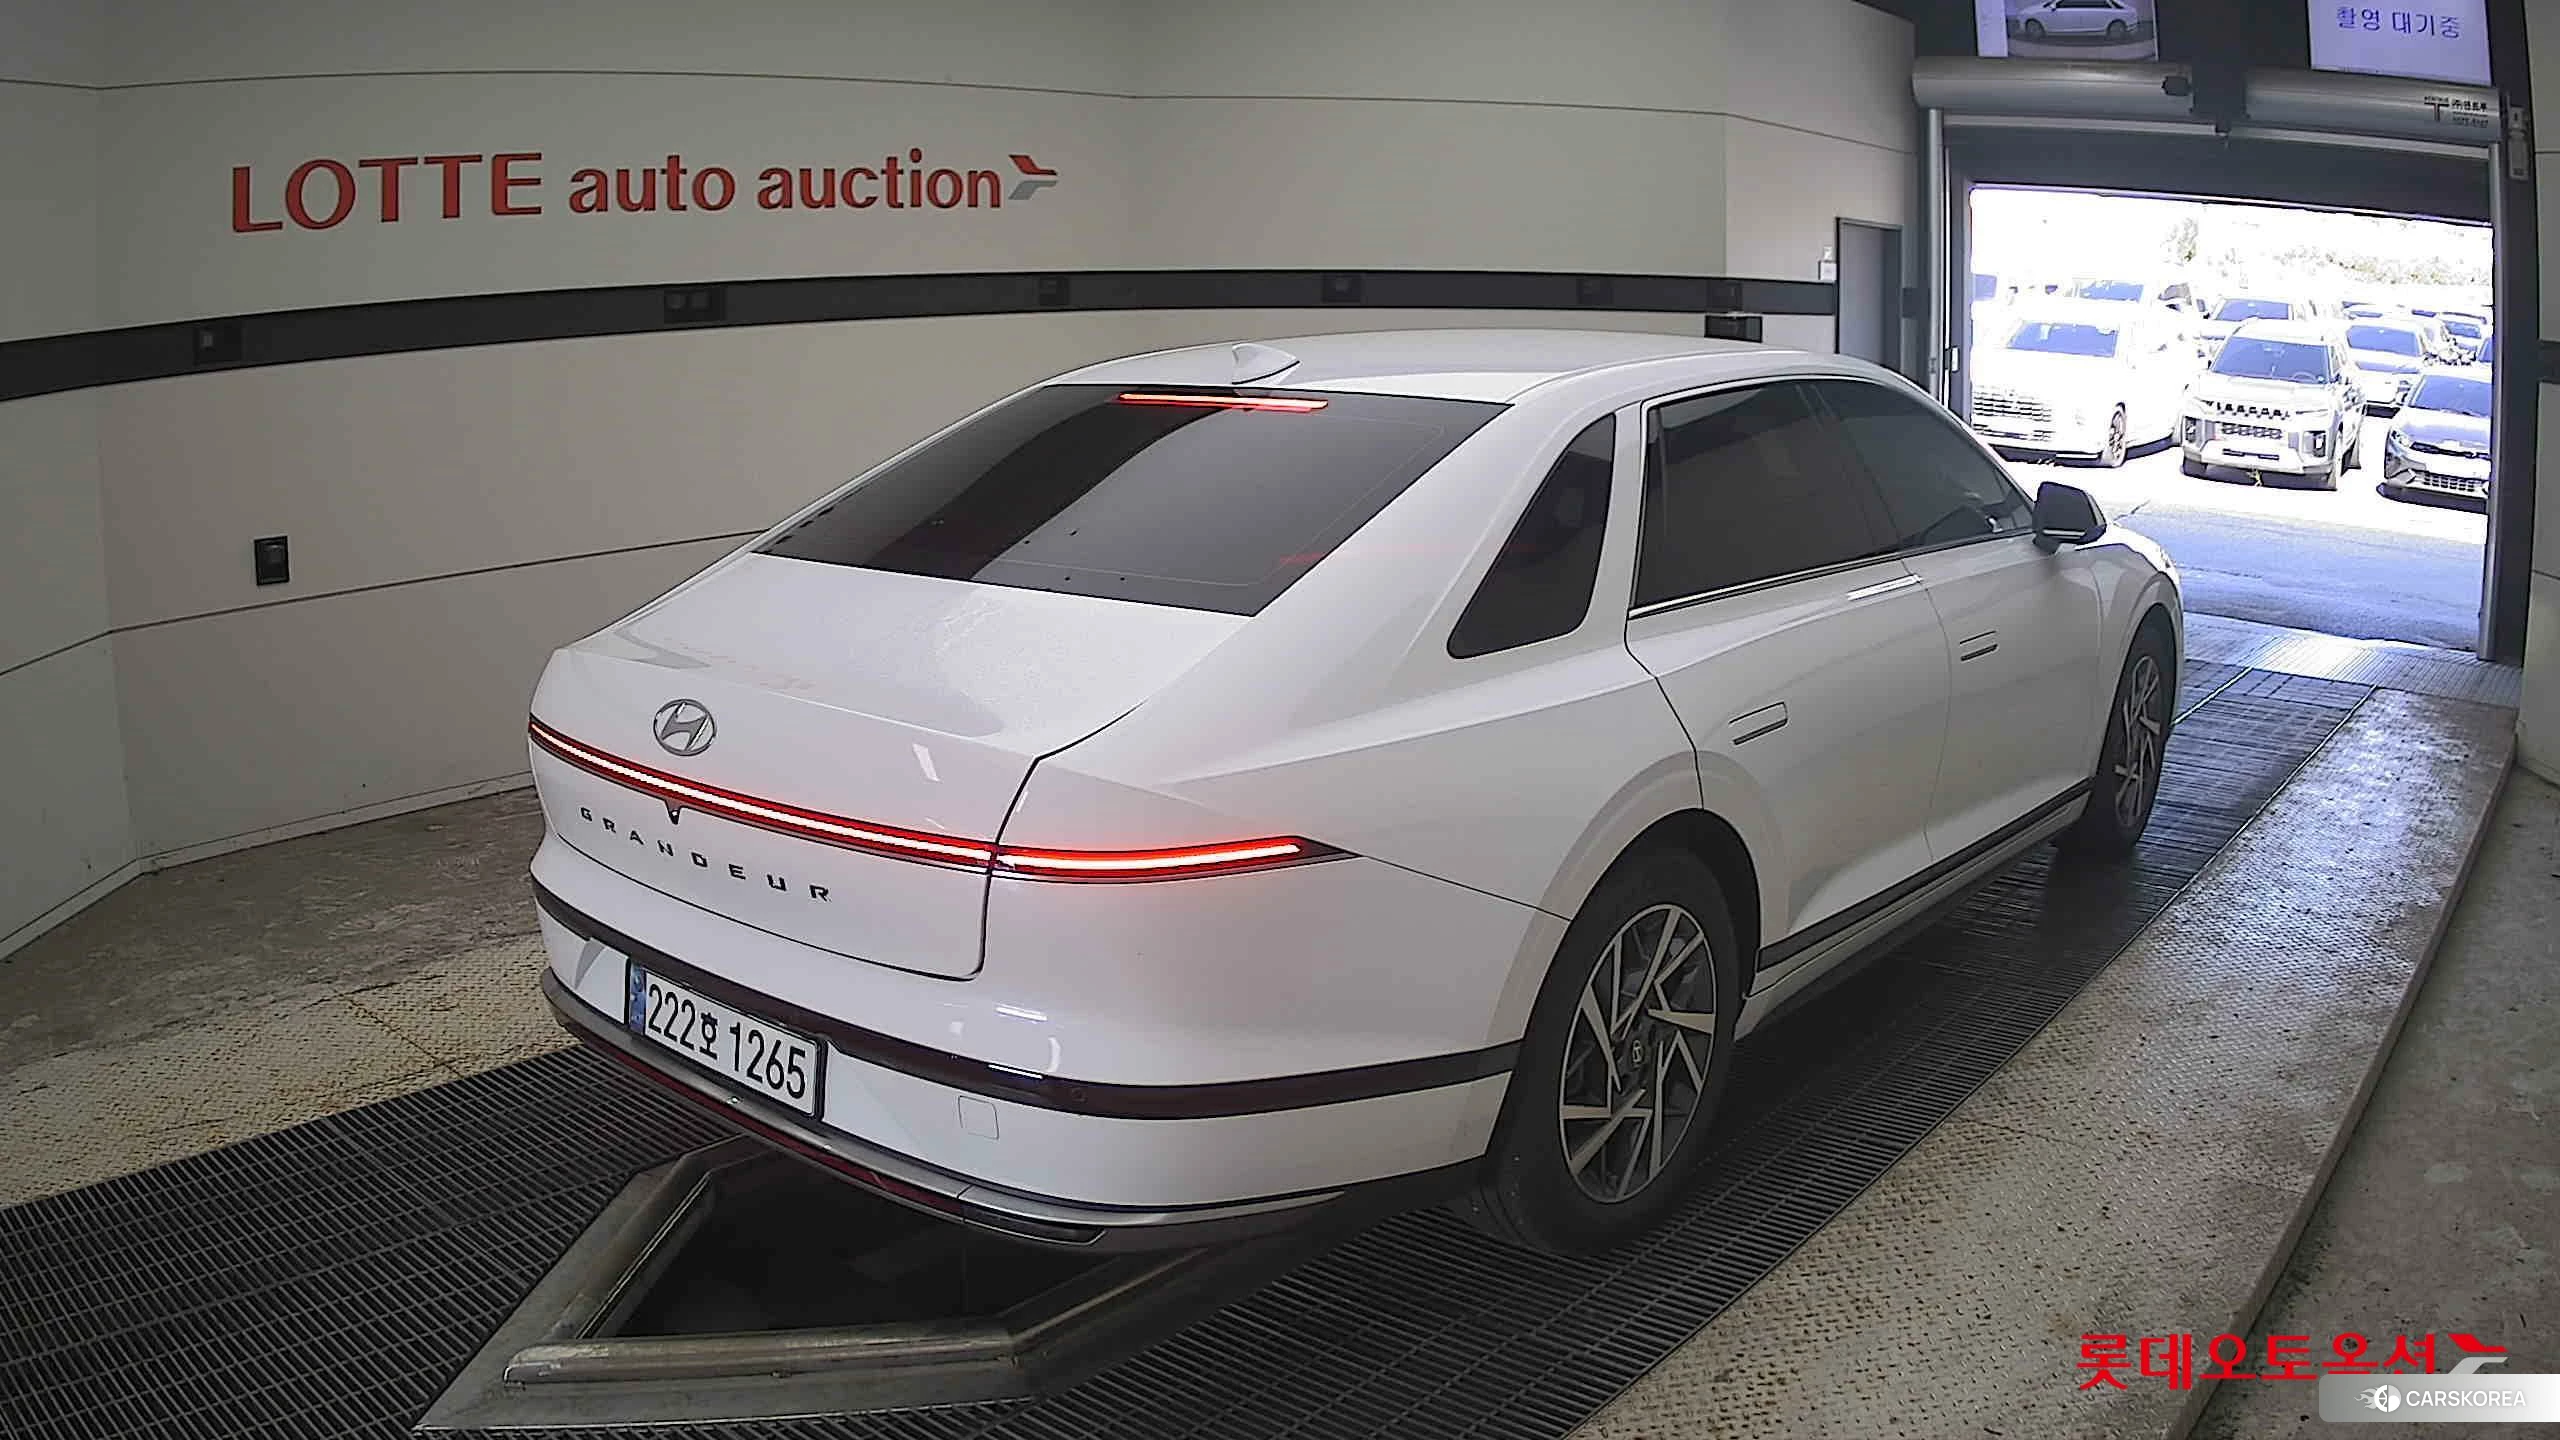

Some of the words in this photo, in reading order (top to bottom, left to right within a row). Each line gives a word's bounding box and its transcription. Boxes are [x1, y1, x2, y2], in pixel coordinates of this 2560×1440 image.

[2337, 6, 2380, 31] 촬영
[2392, 11, 2459, 39] 대기중
[232, 152, 543, 233] LOTTE
[569, 154, 735, 213] auto
[757, 148, 1001, 210] auction
[579, 806, 832, 902] GRANDEUR
[648, 983, 718, 1060] 222호
[729, 1021, 807, 1099] 1265
